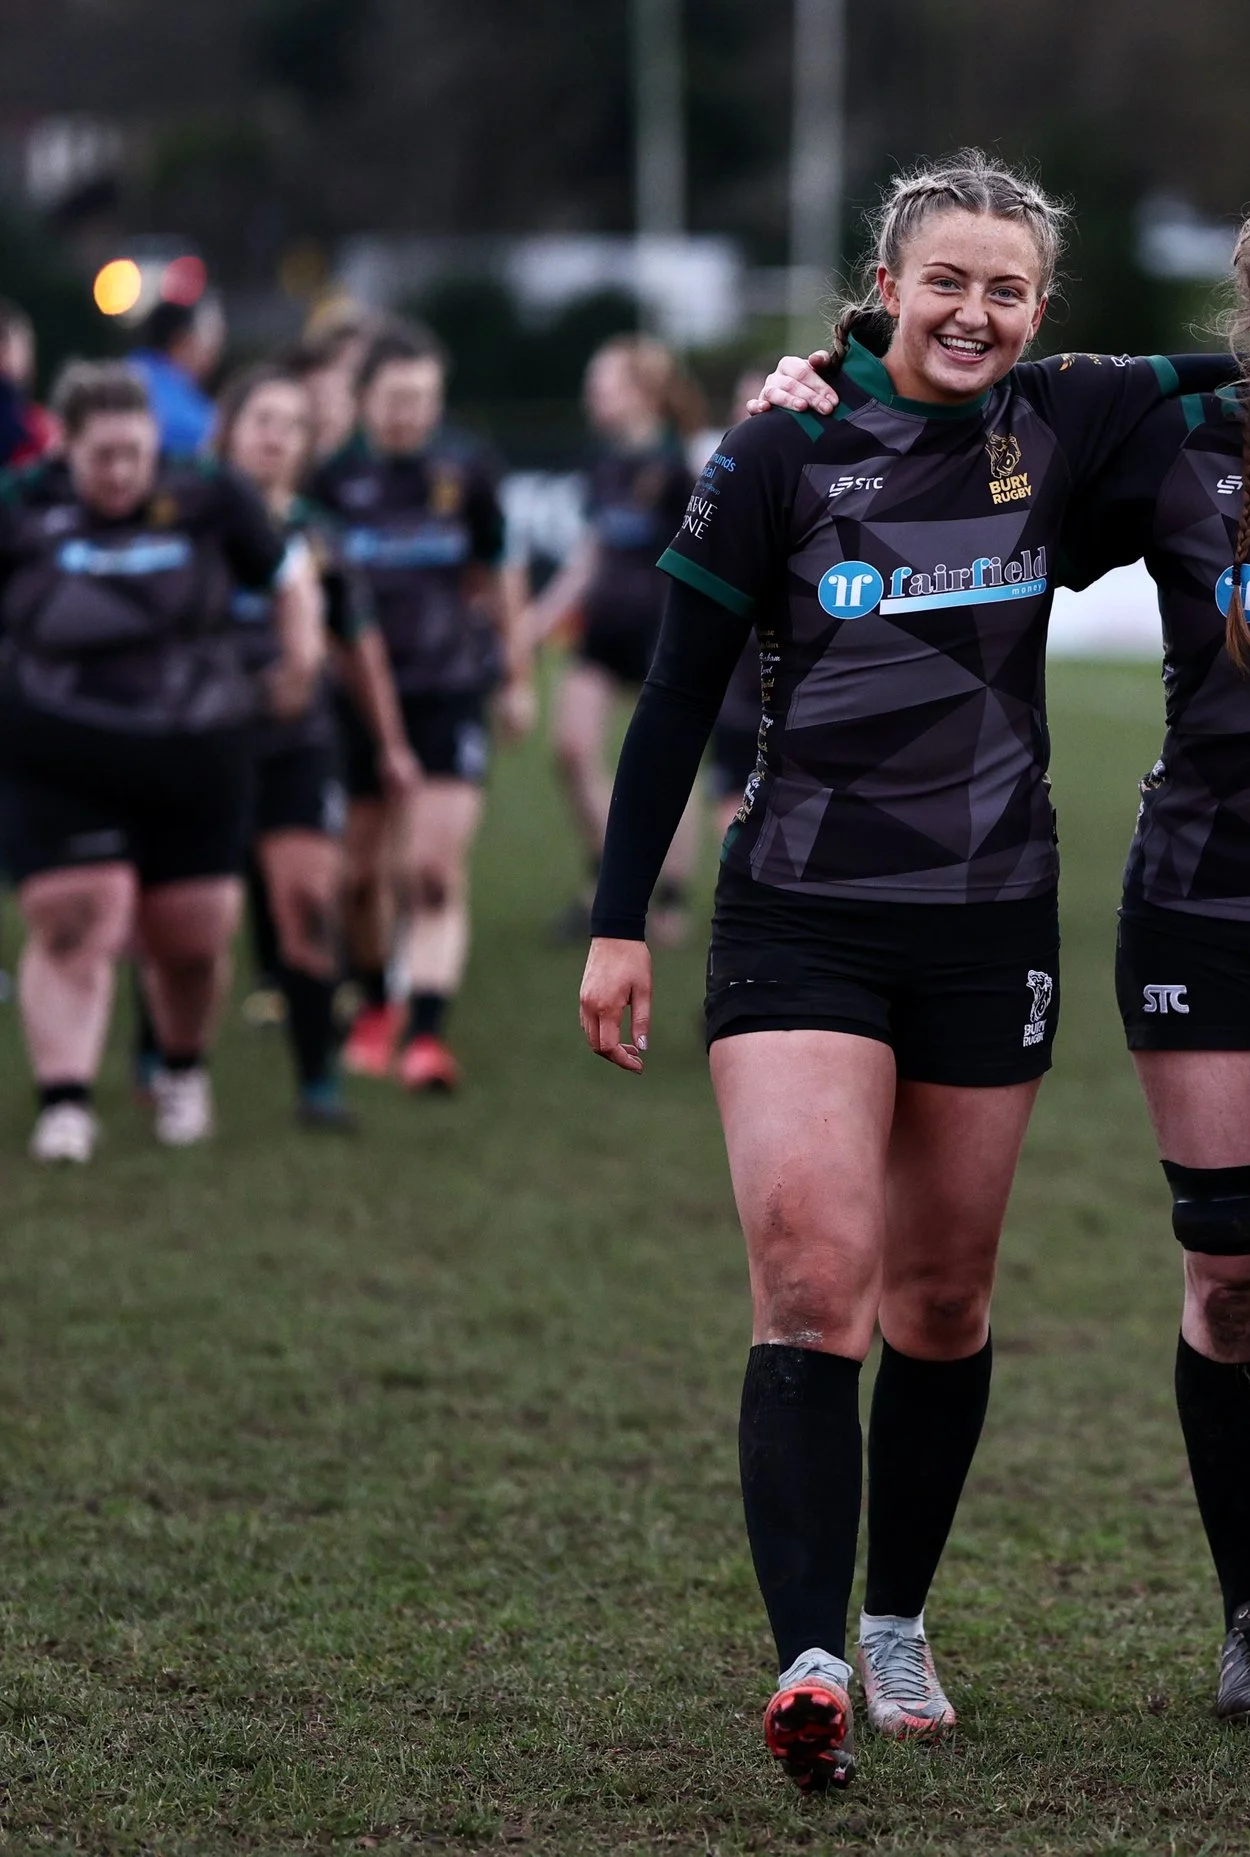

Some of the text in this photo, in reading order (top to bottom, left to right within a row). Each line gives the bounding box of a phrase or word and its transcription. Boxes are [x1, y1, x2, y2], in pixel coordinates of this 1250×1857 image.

[711, 453, 737, 472] unds
[855, 477, 884, 490] STC
[988, 472, 1028, 495] BURY
[992, 484, 1032, 505] RUGBY
[887, 546, 1048, 598] fairfield
[1011, 582, 1043, 596] money
[1143, 984, 1190, 1014] STC
